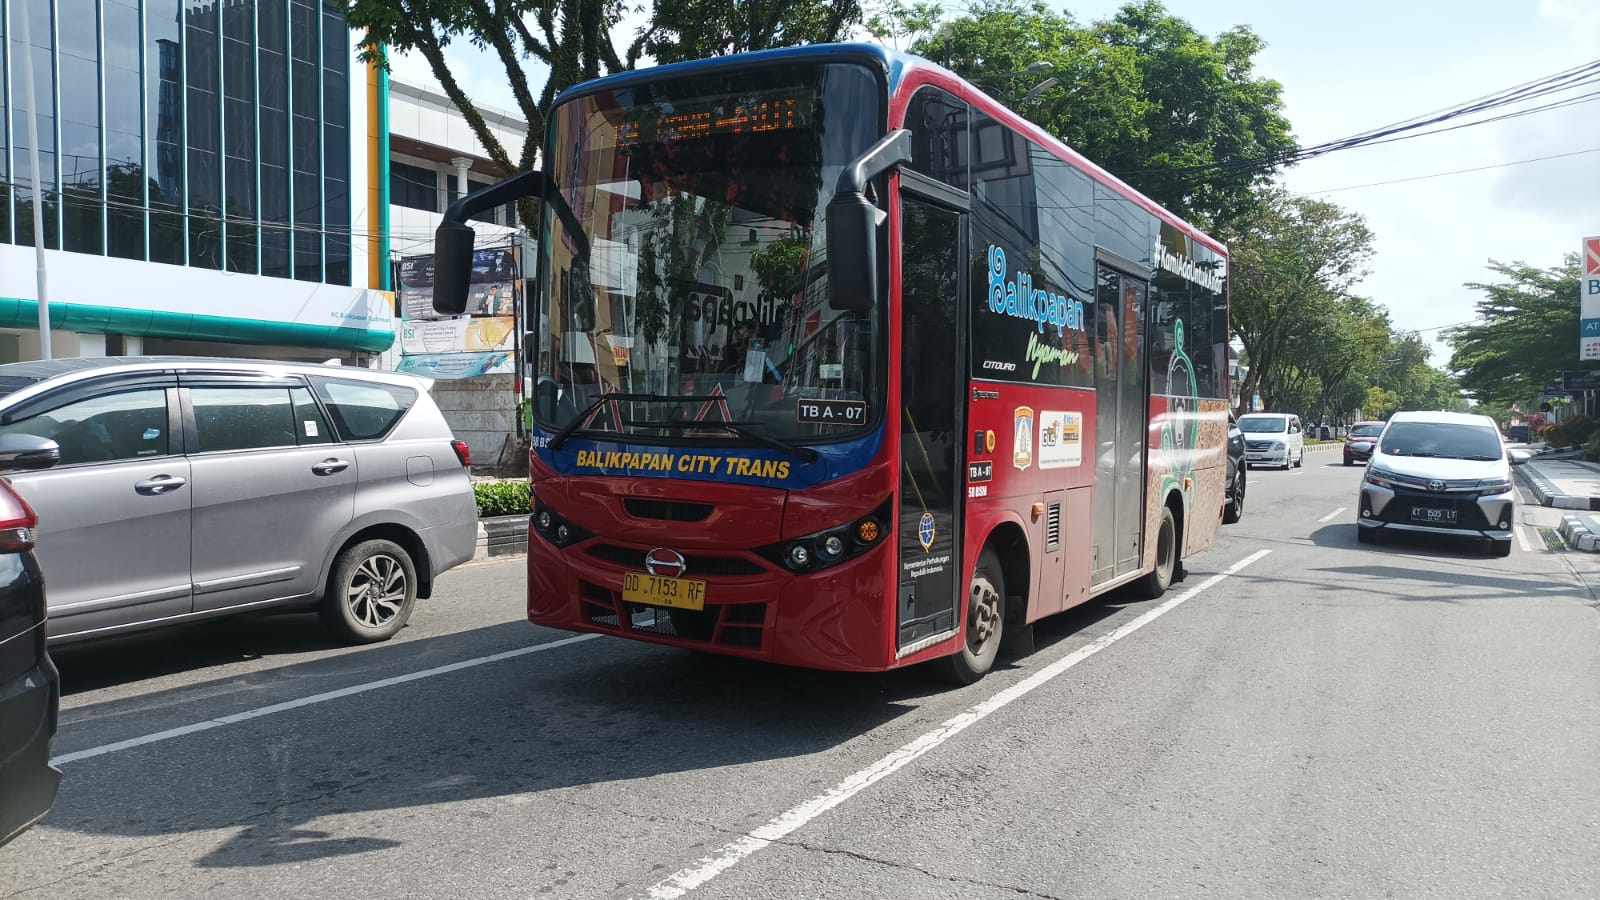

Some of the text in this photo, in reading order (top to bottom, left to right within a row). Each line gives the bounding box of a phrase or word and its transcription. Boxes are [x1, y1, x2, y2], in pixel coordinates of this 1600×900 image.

[988, 244, 1085, 338] Balikpapan
[403, 328, 415, 339] BSI
[982, 360, 1016, 371] CITOURO
[1025, 331, 1079, 380] Nyaman
[800, 405, 819, 417] TB
[822, 406, 833, 418] A
[846, 407, 862, 419] 07
[576, 450, 791, 479] BALIKPAPAN CITY TRANS
[624, 574, 704, 600] DD 7153 RF
